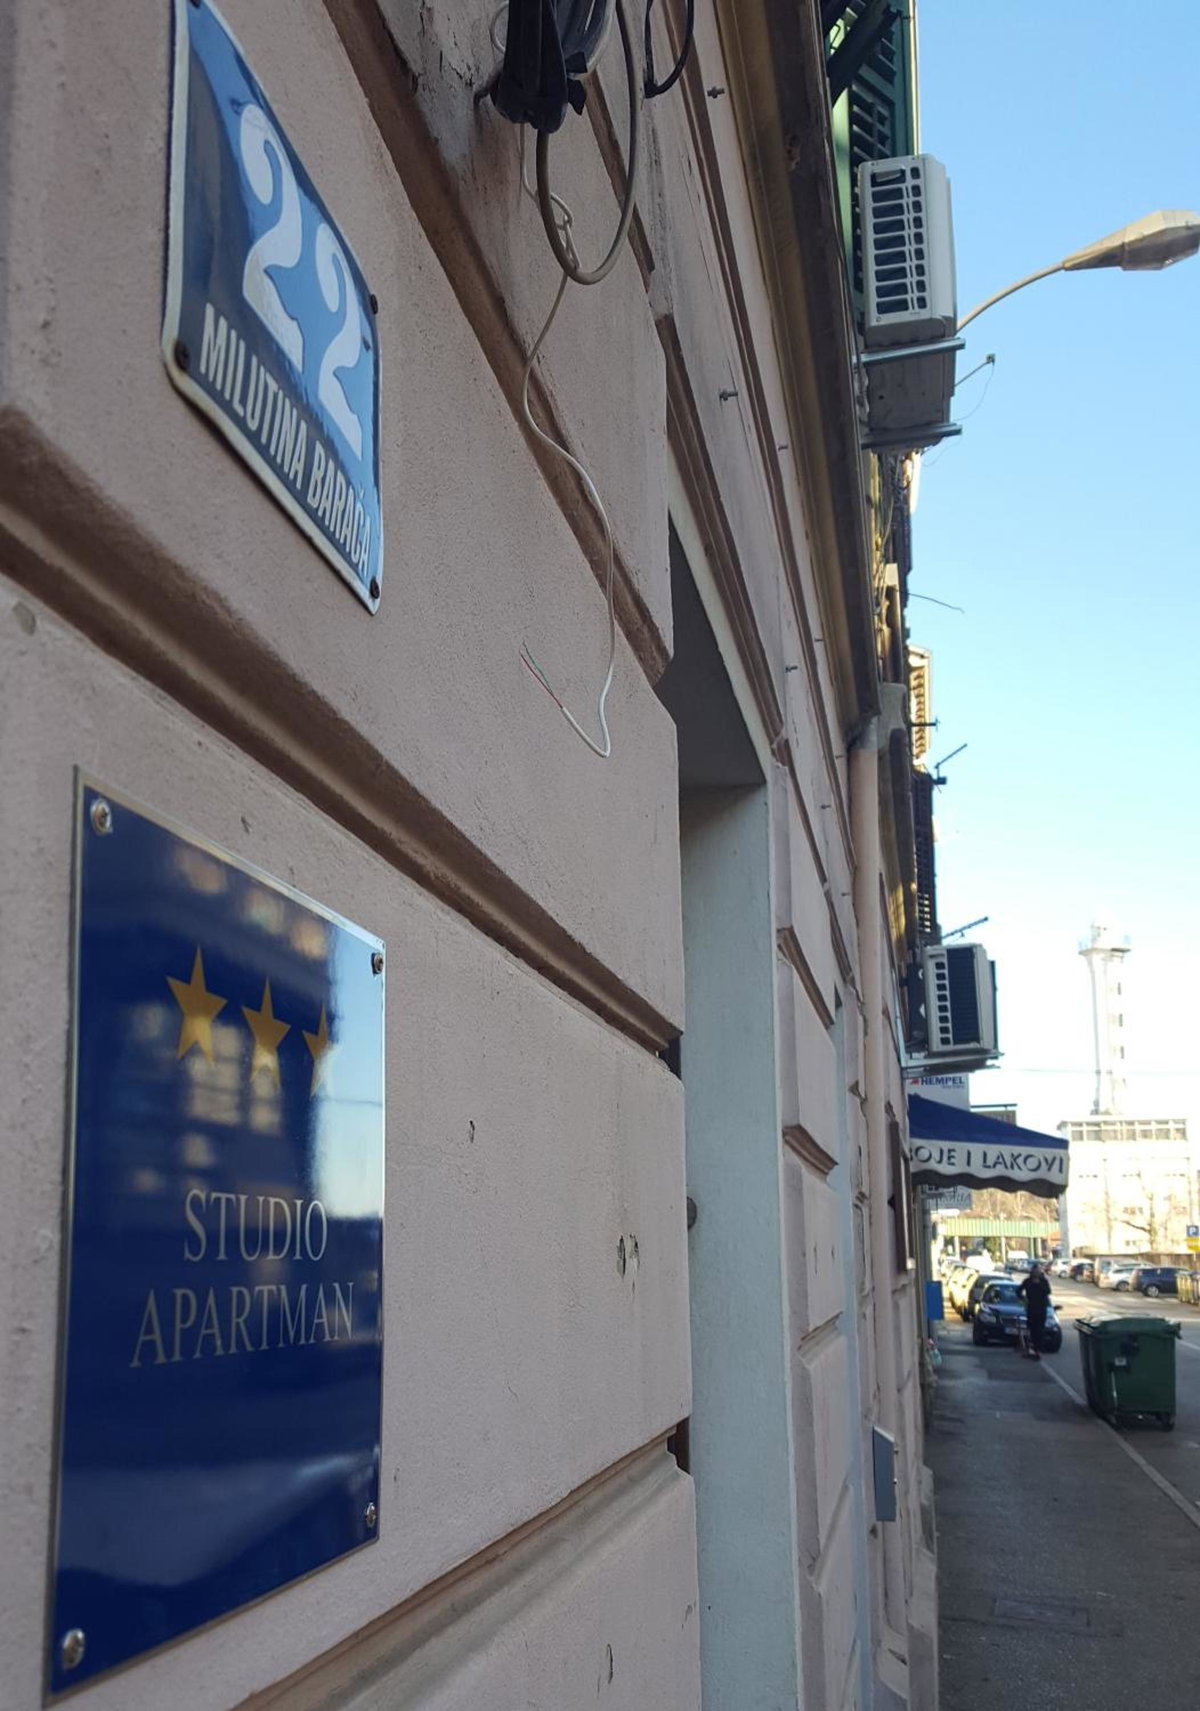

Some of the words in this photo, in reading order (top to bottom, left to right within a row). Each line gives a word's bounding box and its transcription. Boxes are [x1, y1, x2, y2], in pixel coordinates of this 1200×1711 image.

[239, 103, 363, 462] 22
[200, 302, 307, 490] MILUTINA
[307, 439, 371, 577] BARAČA
[921, 1076, 965, 1085] HEMPEL
[966, 1149, 972, 1167] I
[982, 1150, 1064, 1174] LAKOVI
[184, 1189, 328, 1262] STUDIO
[129, 1281, 355, 1369] APARTMAN
